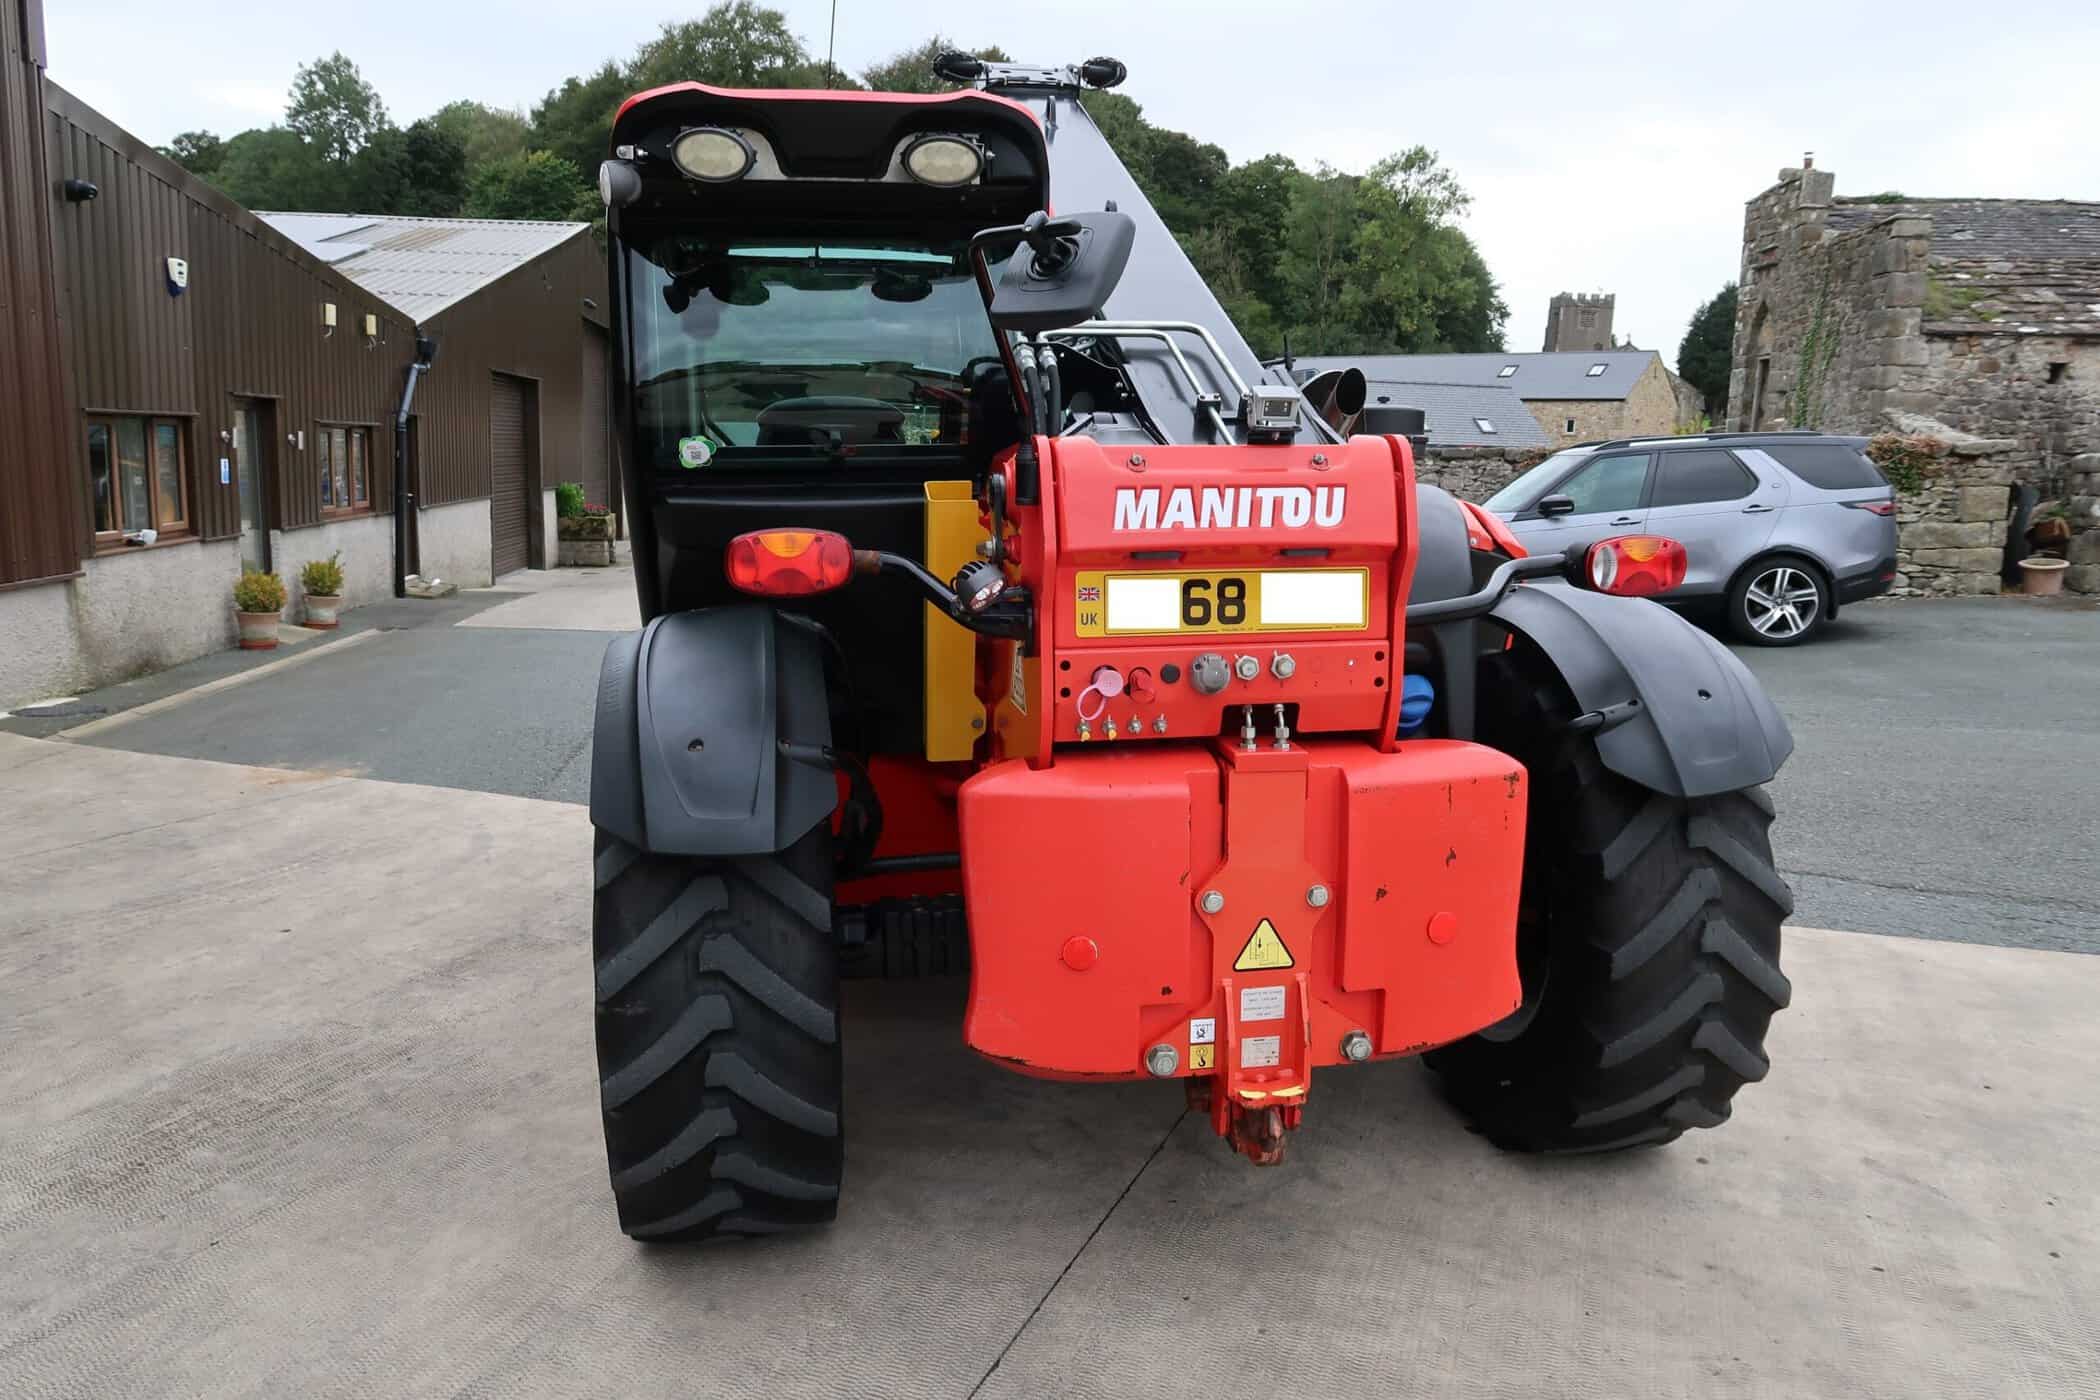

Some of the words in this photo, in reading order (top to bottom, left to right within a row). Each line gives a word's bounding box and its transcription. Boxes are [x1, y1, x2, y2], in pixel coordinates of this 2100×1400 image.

[1113, 486, 1346, 530] MANITOU
[1080, 612, 1098, 626] UK
[1182, 577, 1246, 626] 68
